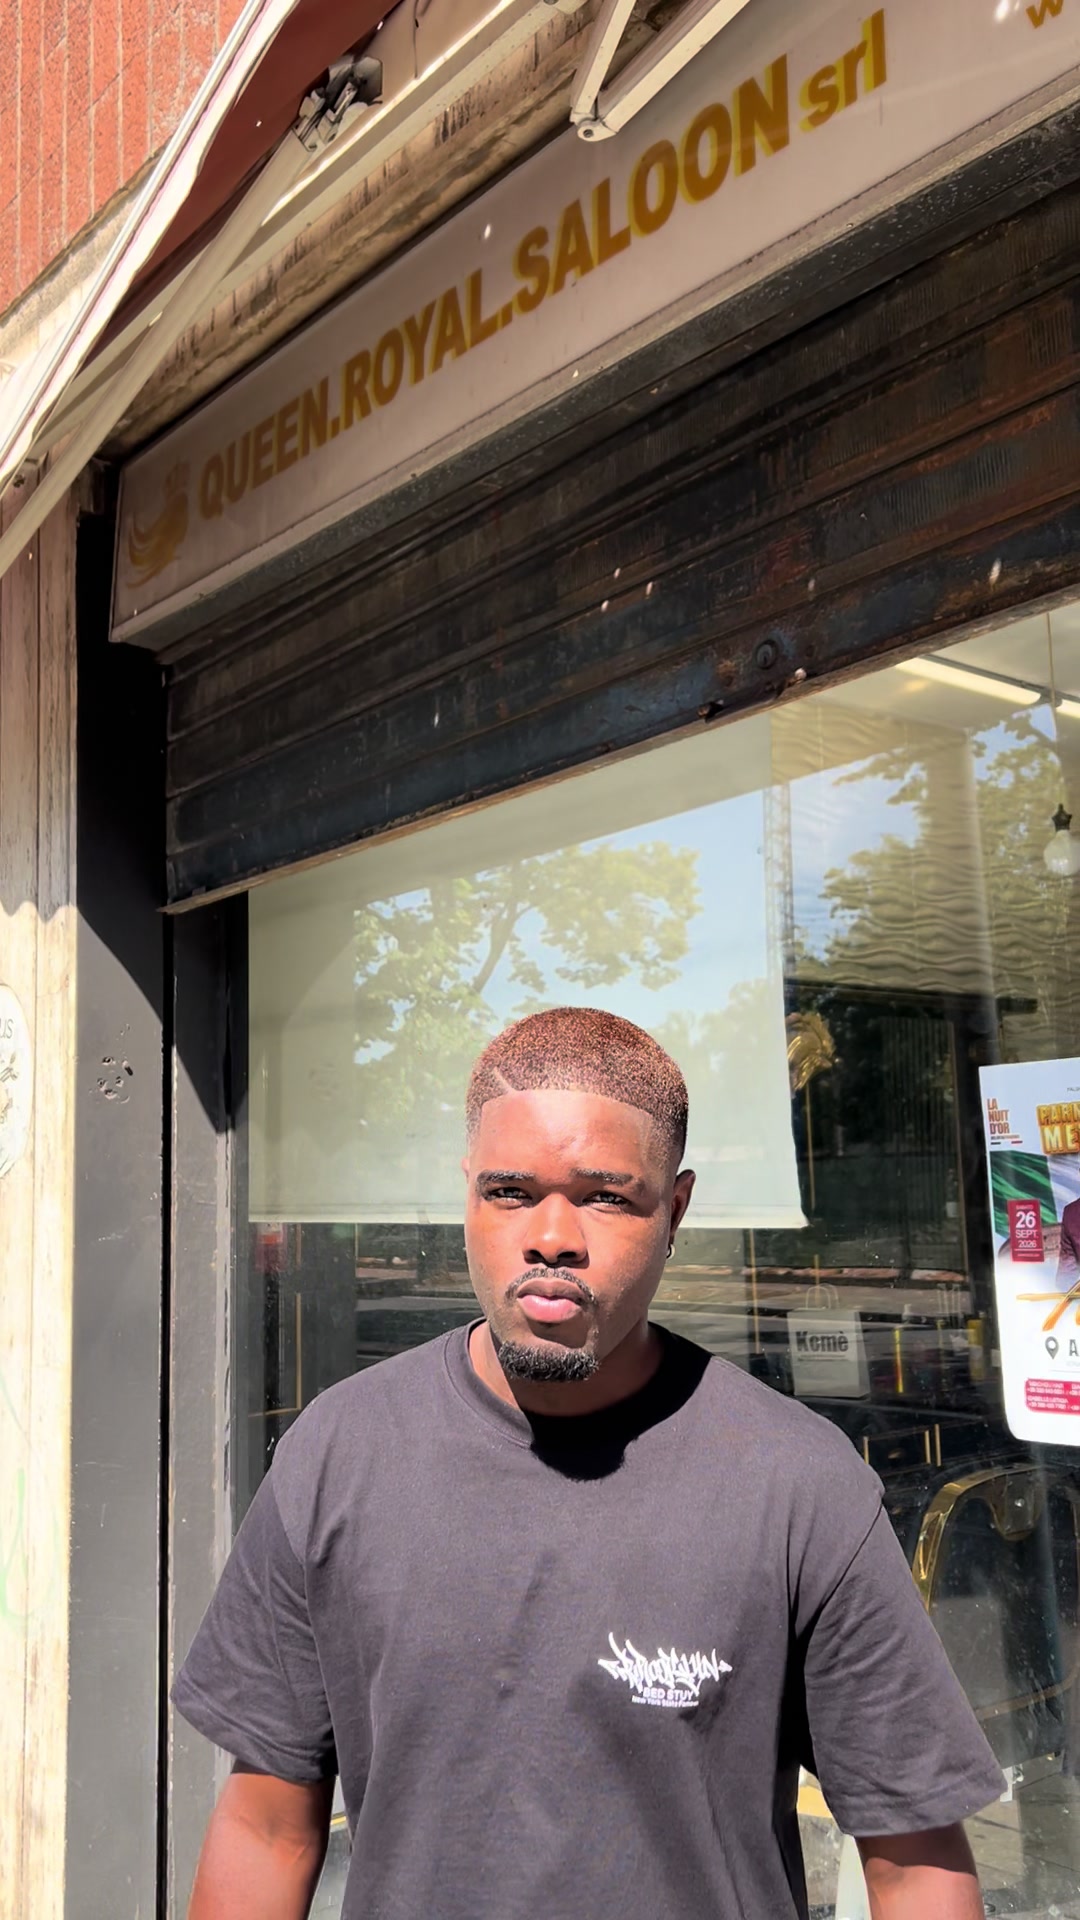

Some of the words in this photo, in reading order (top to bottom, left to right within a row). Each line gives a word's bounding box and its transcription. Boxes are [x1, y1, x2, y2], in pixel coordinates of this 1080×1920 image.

[800, 8, 887, 133] srl
[987, 1098, 998, 1110] LA
[988, 1109, 1009, 1122] NUIT
[990, 1122, 1010, 1134] D'OR
[1015, 1211, 1037, 1228] 26
[1015, 1230, 1039, 1239] SEPT.
[1018, 1240, 1037, 1248] 2026
[643, 1687, 666, 1699] BED
[666, 1688, 694, 1701] STUY
